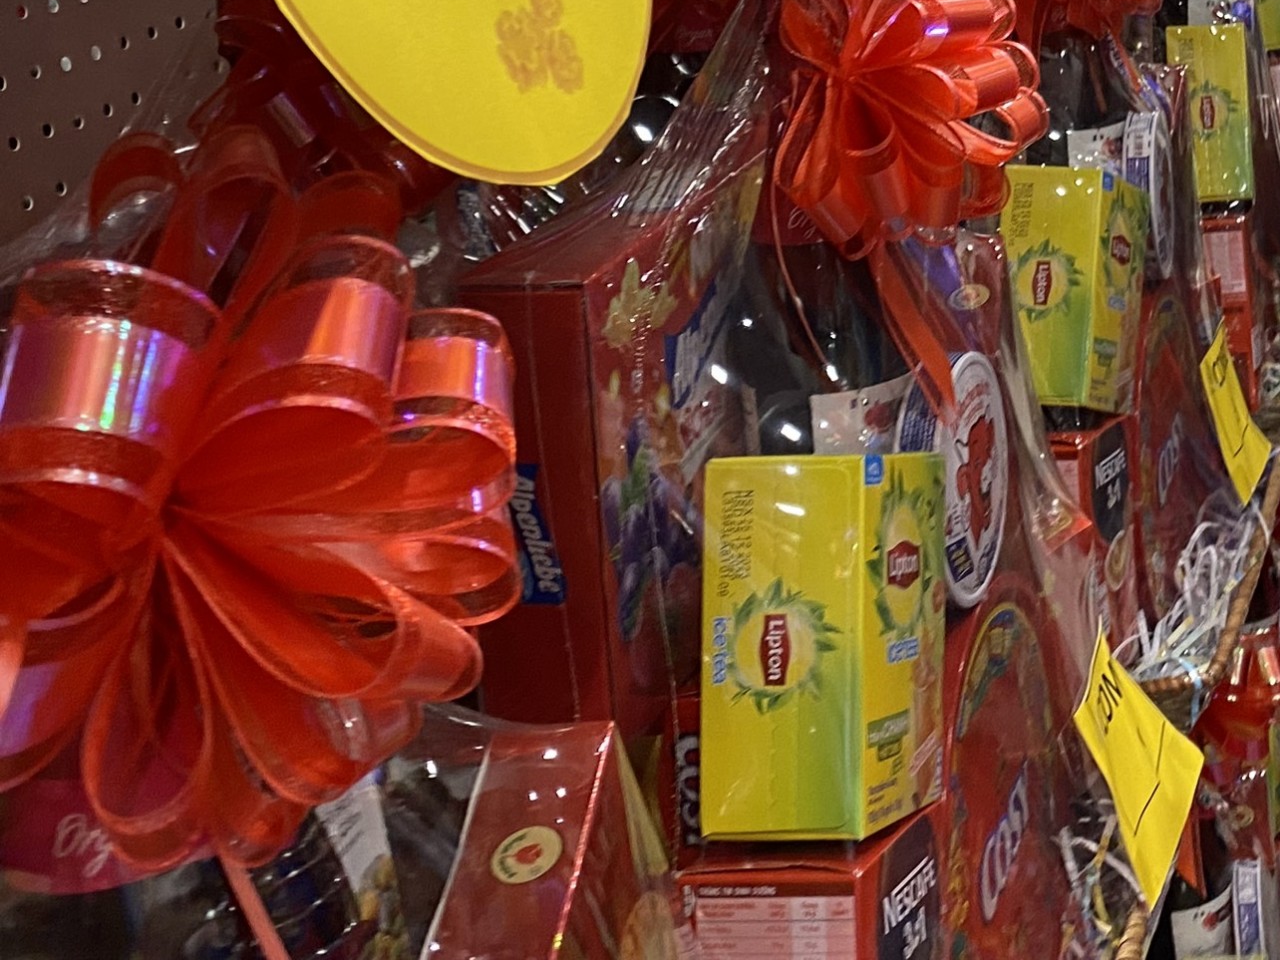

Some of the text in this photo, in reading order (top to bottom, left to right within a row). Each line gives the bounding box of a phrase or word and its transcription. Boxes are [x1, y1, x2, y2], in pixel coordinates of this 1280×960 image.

[1035, 263, 1050, 304] Lipton
[513, 472, 564, 595] Alpenliebe
[888, 551, 920, 583] Lipton
[712, 616, 730, 649] ice
[764, 618, 783, 682] Lipton
[711, 652, 729, 686] tea
